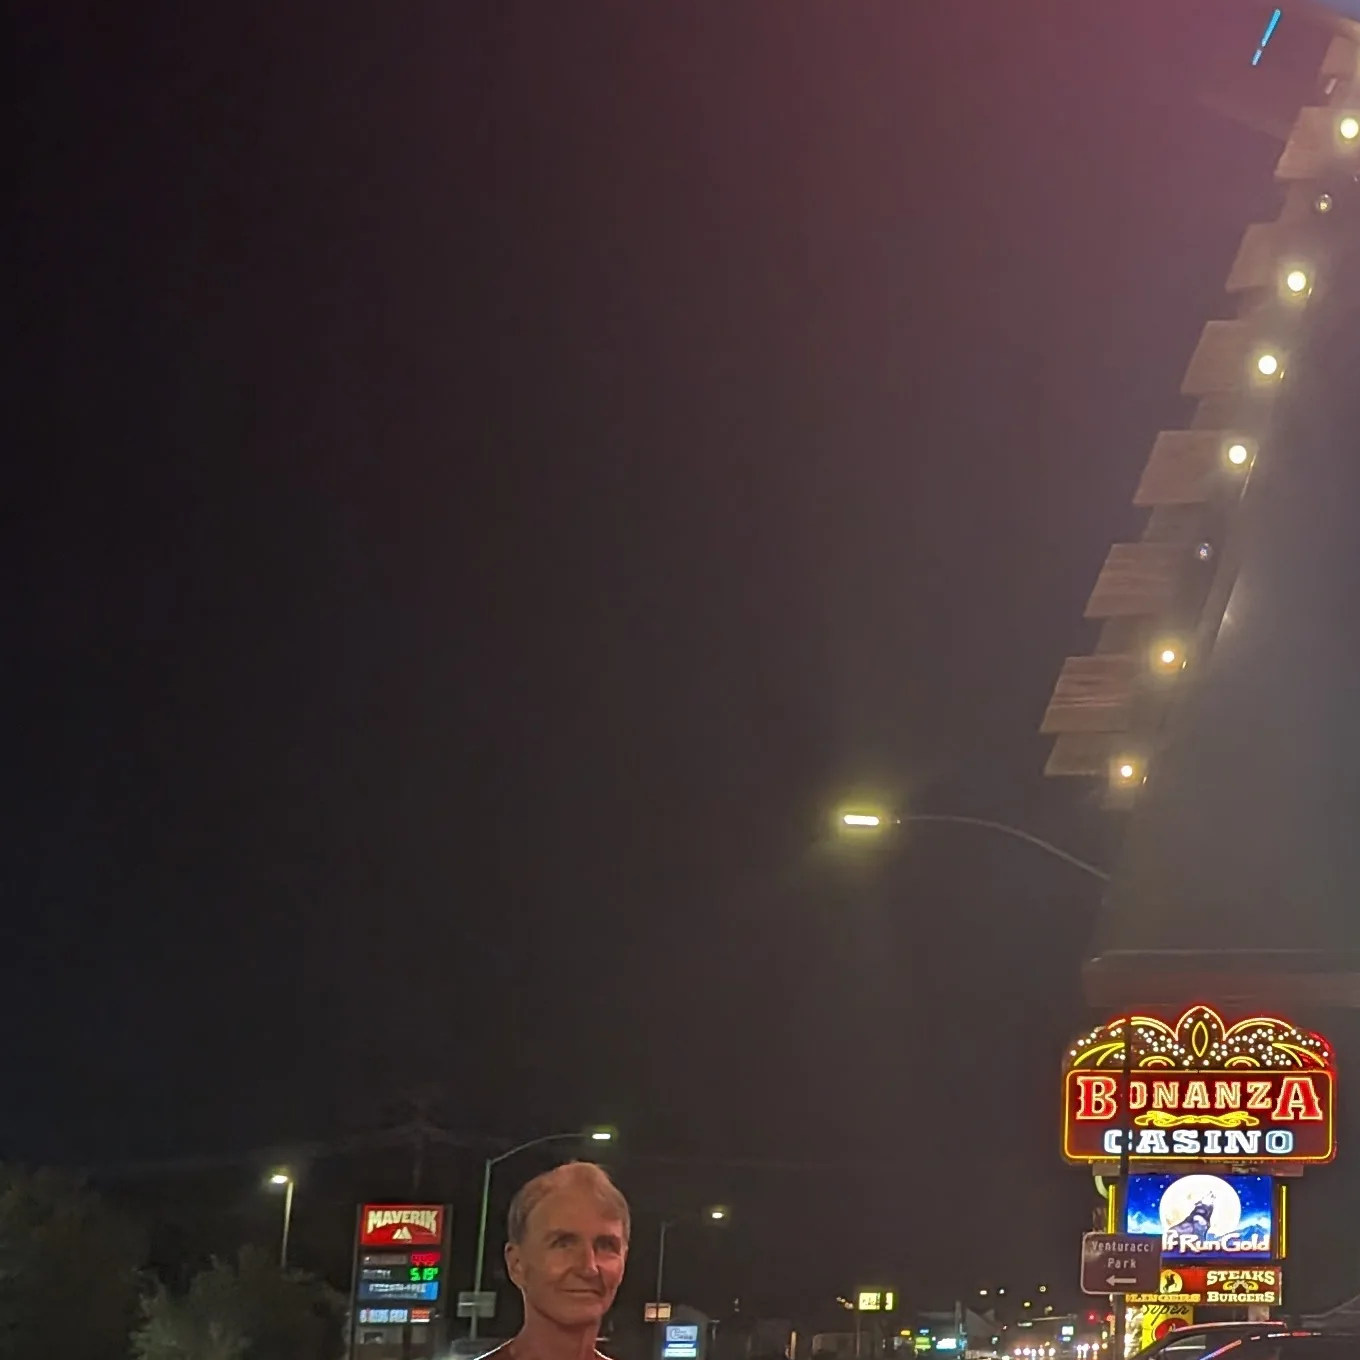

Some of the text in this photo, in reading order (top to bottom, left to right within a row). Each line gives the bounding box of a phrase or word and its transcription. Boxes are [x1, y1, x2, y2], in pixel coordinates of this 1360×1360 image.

[1076, 1076, 1323, 1120] BONANZA
[1104, 1129, 1293, 1154] CASINO
[367, 1210, 438, 1237] MAVERIK
[1107, 1257, 1136, 1269] Park
[1206, 1269, 1275, 1286] STEAKS
[1206, 1291, 1275, 1303] BURGERS
